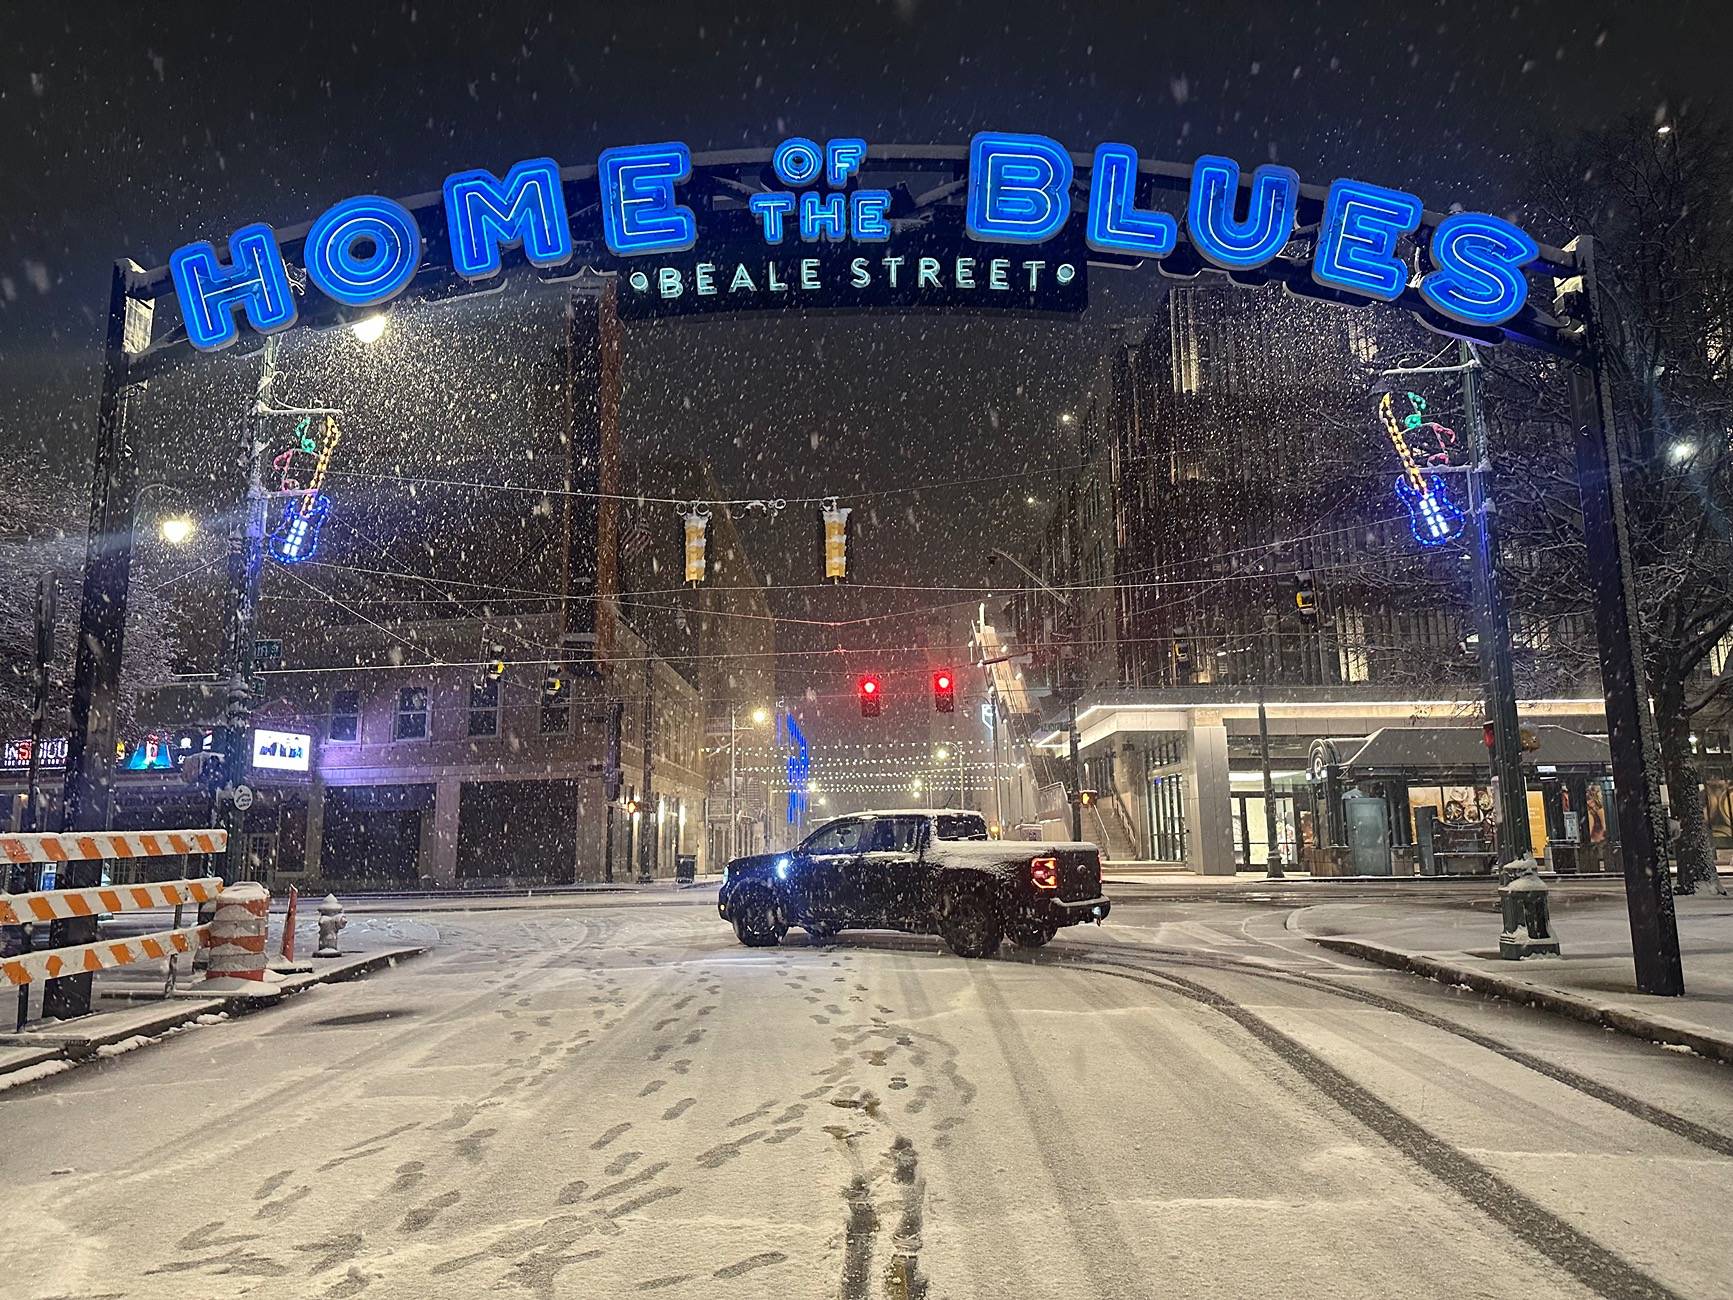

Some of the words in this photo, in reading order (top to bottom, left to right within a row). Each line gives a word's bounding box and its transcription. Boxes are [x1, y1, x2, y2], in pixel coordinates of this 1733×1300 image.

[773, 137, 867, 188] OF
[750, 190, 892, 245] THE
[966, 131, 1539, 326] BLUES
[169, 141, 697, 351] HOME
[659, 258, 822, 298] BEALE
[850, 256, 1046, 291] STREET
